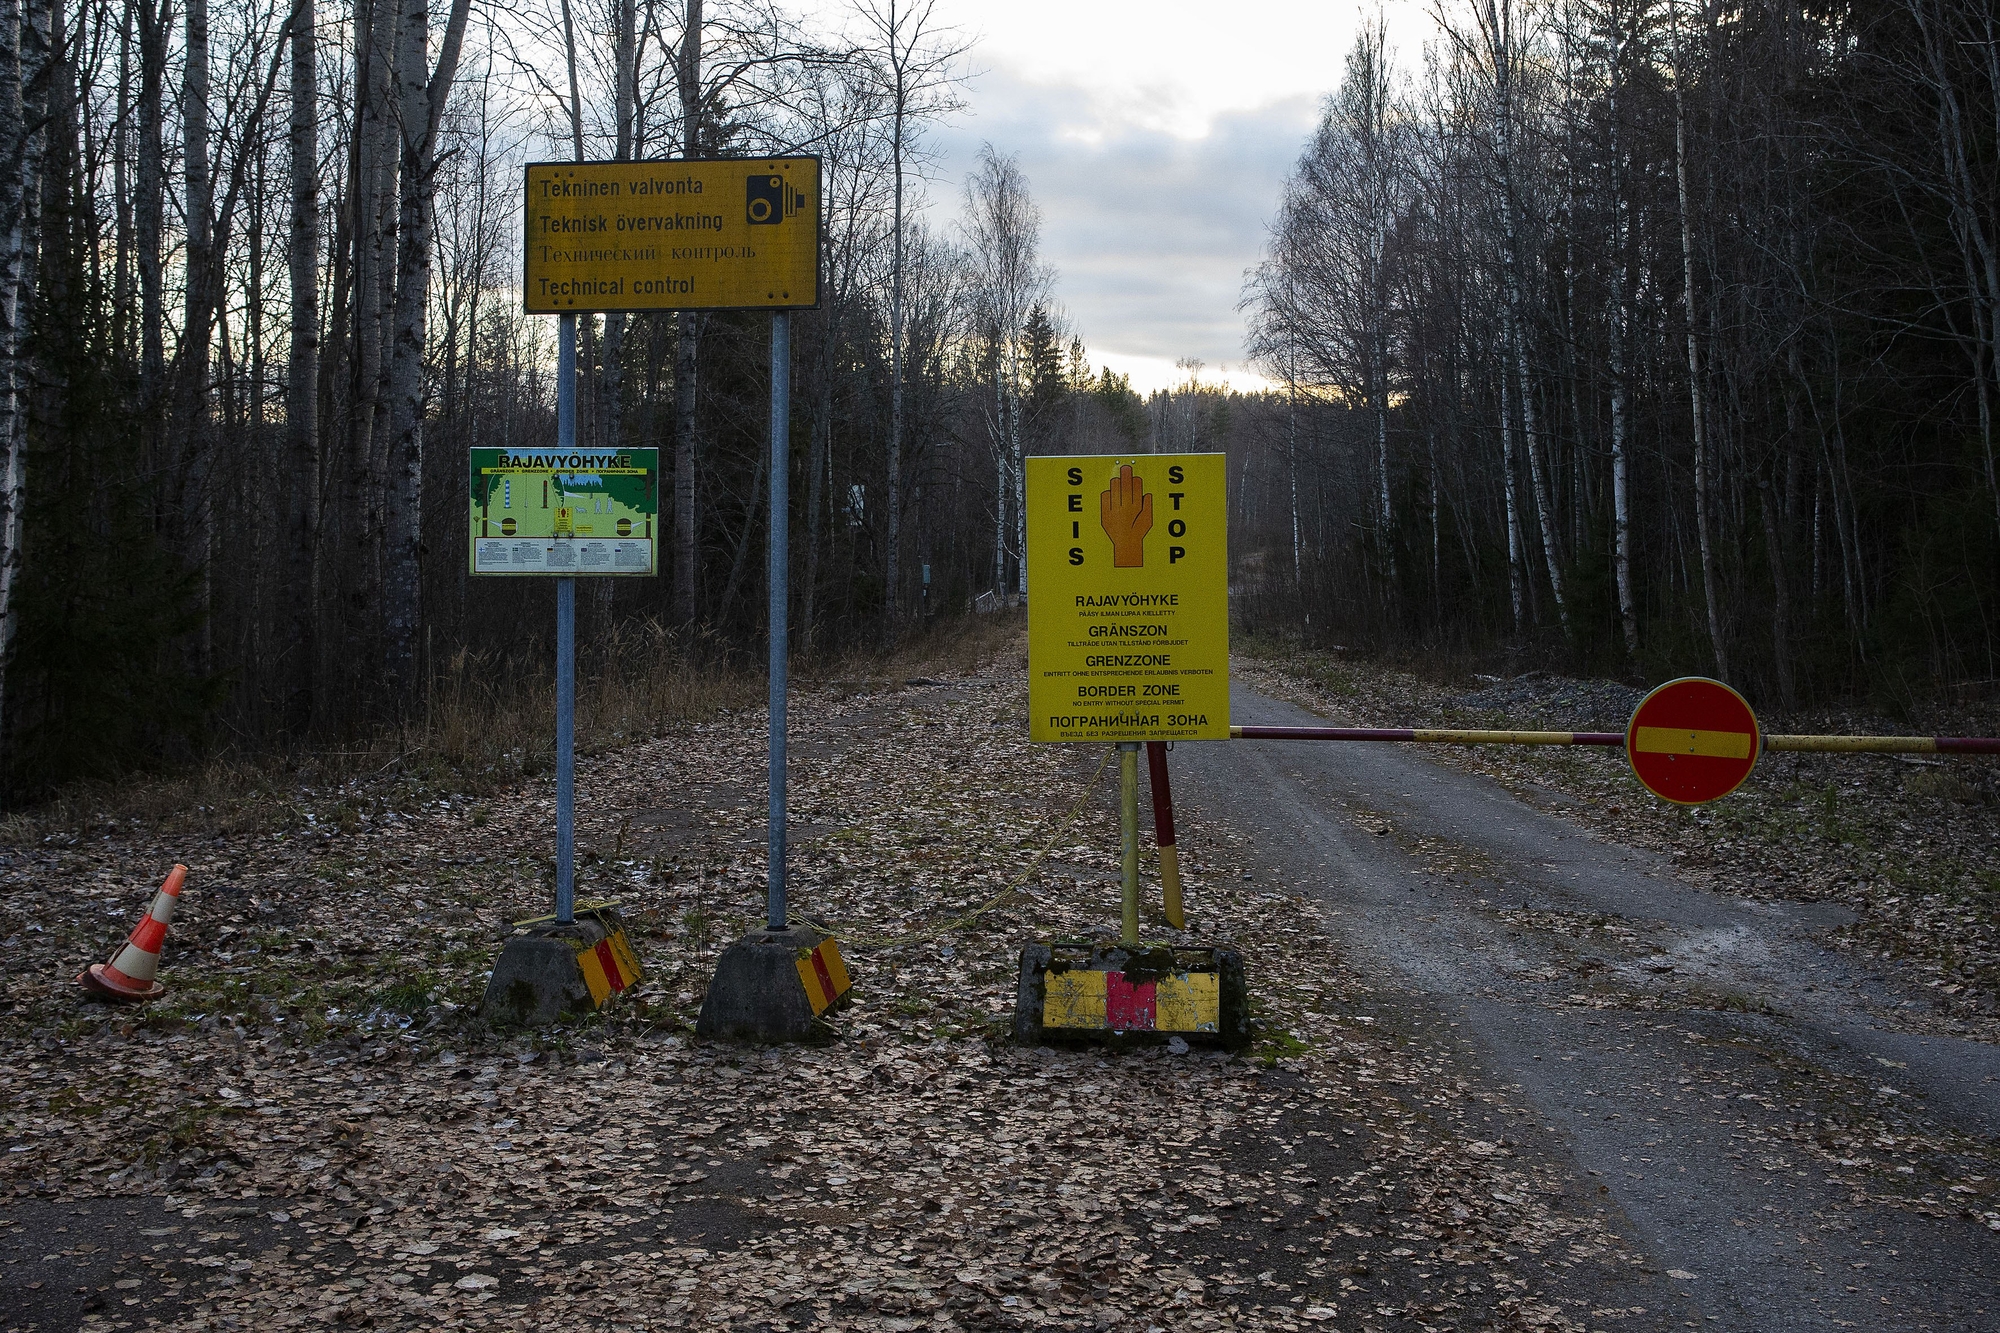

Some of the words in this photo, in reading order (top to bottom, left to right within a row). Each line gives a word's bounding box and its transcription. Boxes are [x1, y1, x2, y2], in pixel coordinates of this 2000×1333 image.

[539, 179, 620, 198] Tekninen
[629, 177, 703, 196] valvonta
[539, 215, 608, 233] Teknisk
[616, 213, 723, 232] övervakning
[539, 244, 656, 263] Технический
[671, 245, 757, 262] контроль
[538, 277, 624, 295] Technical
[633, 275, 695, 294] control
[498, 451, 631, 469] RAJAVYÖHYKE
[1067, 467, 1084, 566] SEIS
[1168, 466, 1186, 564] STOP
[1075, 592, 1179, 607] RAJAVYÖHYKE
[1088, 622, 1168, 637] GRÄNSZON
[1085, 654, 1171, 667] GRENZZONE
[1078, 685, 1136, 697] BORDER
[1142, 684, 1180, 696] ZONE
[1050, 714, 1160, 728] ПОГРАНИЧНАЯ
[1167, 714, 1208, 726] ЗОНА
[1060, 730, 1083, 738] ВЪЕЗД
[1149, 729, 1198, 737] ЗАПРЕЩАЕТСЯ
